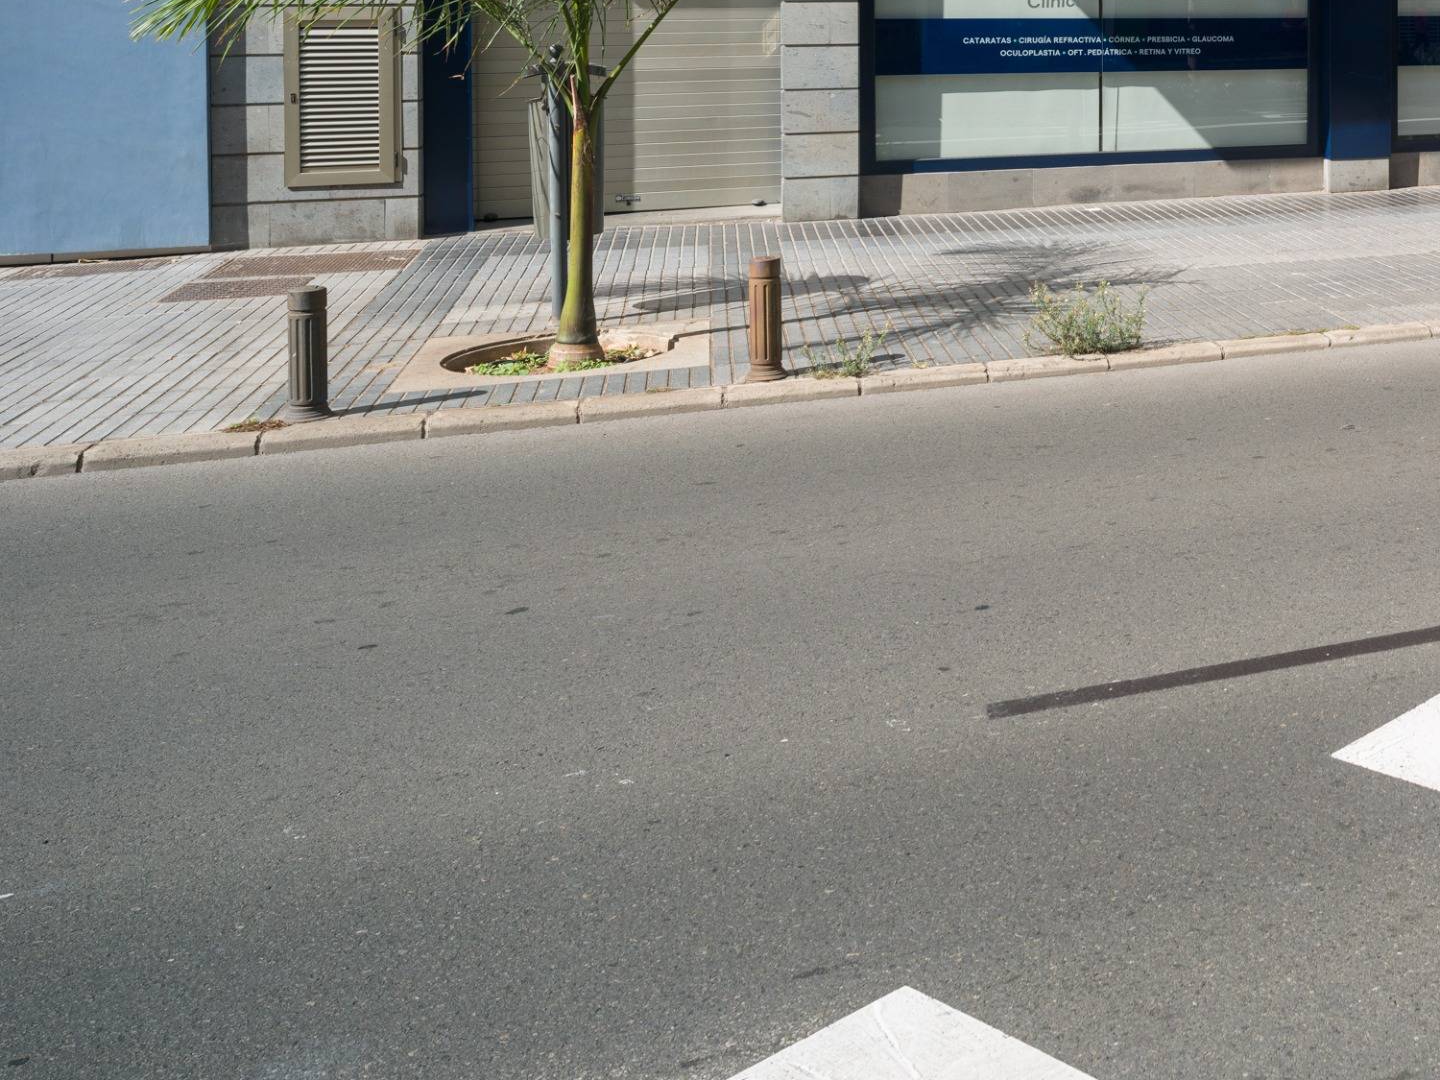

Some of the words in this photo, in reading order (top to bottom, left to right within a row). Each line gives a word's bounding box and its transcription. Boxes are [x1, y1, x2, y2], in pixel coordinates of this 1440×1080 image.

[963, 36, 1012, 44] CATARATAS
[1018, 35, 1052, 44] CIRUGÍA
[1053, 36, 1102, 44] REFRACTIVA
[1146, 36, 1186, 44] PRESBICIA
[1191, 35, 1235, 44] GLAUCOMA
[999, 49, 1061, 57] OCULOPLASTIA
[1139, 48, 1166, 57] RETINA
[1167, 48, 1173, 56] Y
